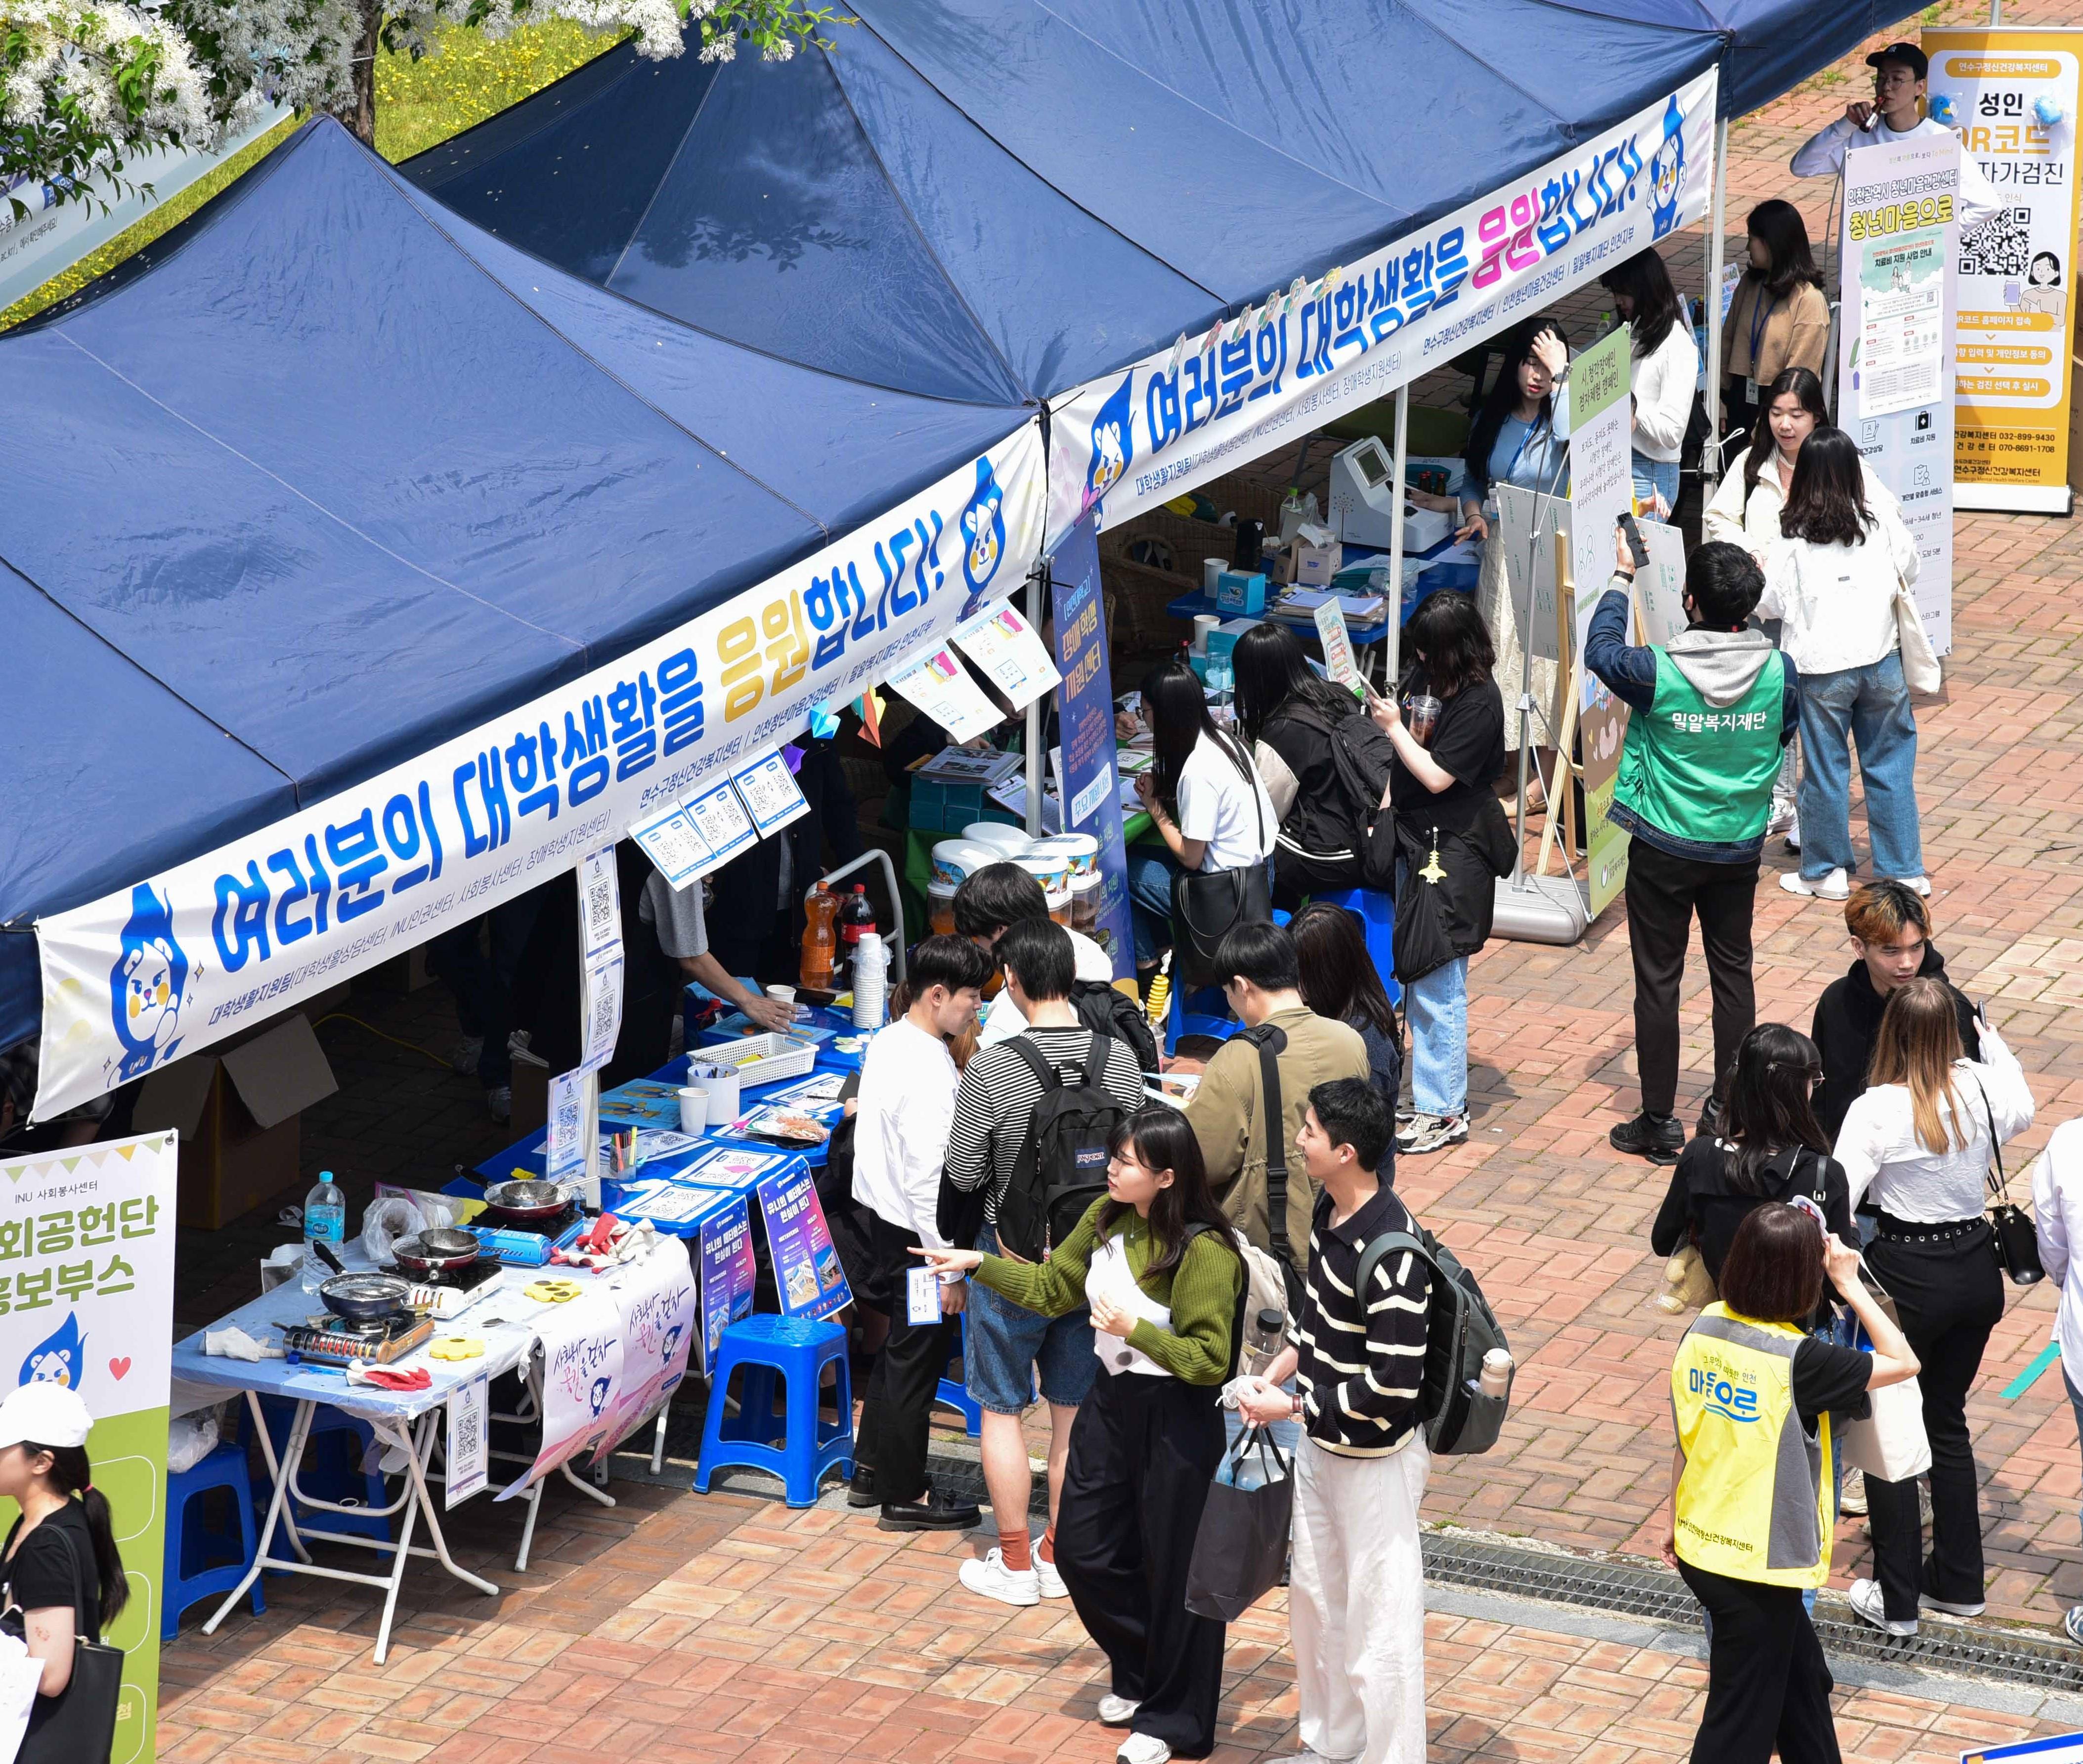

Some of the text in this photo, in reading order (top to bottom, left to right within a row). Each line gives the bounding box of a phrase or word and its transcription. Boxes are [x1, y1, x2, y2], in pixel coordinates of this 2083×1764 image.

[1959, 63, 2047, 73] 연수구정신건강복지센터
[1979, 93, 2023, 116] 성인
[1978, 162, 2063, 185] 자가검진
[1848, 169, 1958, 207] 인천광역시 청년마음건강센터
[2005, 193, 2022, 203] 인식
[1849, 194, 1954, 241] 청년마음으로
[1875, 247, 1932, 267] 치료비 지원 사업 안내
[1147, 132, 1643, 454] 여러분의 대학생활을 응원합니다!
[1423, 224, 1634, 356] 연수구정신건강복지센터 인천청년마음건강센터 밀알복지재단 인천지부
[1956, 315, 2032, 325] R코드 홈페이지 접속
[1968, 348, 1984, 357] 입력
[1986, 349, 1994, 357] 및
[1996, 349, 2028, 359] 개인정보
[2030, 350, 2046, 360] 동의
[1344, 350, 1402, 396] 장애학생지원센터)
[1977, 380, 1992, 390] 검진
[1995, 380, 2010, 390] 선택
[2012, 381, 2020, 390] 후
[2022, 381, 2038, 391] 실시
[1579, 368, 1618, 412] 점자체험 캠페인
[1910, 433, 1936, 445] 치료비 지원
[1999, 433, 2055, 441] 032-899-9430
[1999, 444, 2055, 453] 070-8691-1708
[1954, 465, 2040, 477] 연수구정신건강복지센터
[1915, 490, 1929, 499] 맞춤형
[1929, 487, 1943, 496] 서비스
[1922, 549, 1932, 558] 도보
[1919, 610, 1940, 620] 스타그램
[1062, 598, 1097, 662] 장애학생
[1065, 640, 1101, 704] 지원센터
[640, 616, 936, 809] 연수구정신건강복지센터 인천청년마음건강센터 밀알복지재단 인천지부
[1672, 710, 1767, 733] 밀알복지재단
[212, 509, 944, 972] 여러분의 대학생활을 응원합니다!
[208, 808, 611, 1026] 대학생활지원팀(대학생활상담센터, INU인권센터, 사회봉사센터, 장애학생지원센터)
[15, 1180, 98, 1204] INU 사회봉사센터
[767, 1194, 787, 1215] 유니의
[786, 1178, 811, 1203] 메타버스는
[780, 1194, 810, 1224] 현실이 된다
[0, 1194, 160, 1261] 회공헌단
[705, 1235, 722, 1256] 유니의
[723, 1220, 748, 1245] 메타버스는
[715, 1237, 742, 1266] 현실이 된다
[630, 1293, 660, 1335] 사회봉사
[661, 1285, 691, 1320] 걷자
[554, 1338, 587, 1376] 사회봉사
[587, 1335, 617, 1368] 걷자
[1742, 1371, 1757, 1384] 인천
